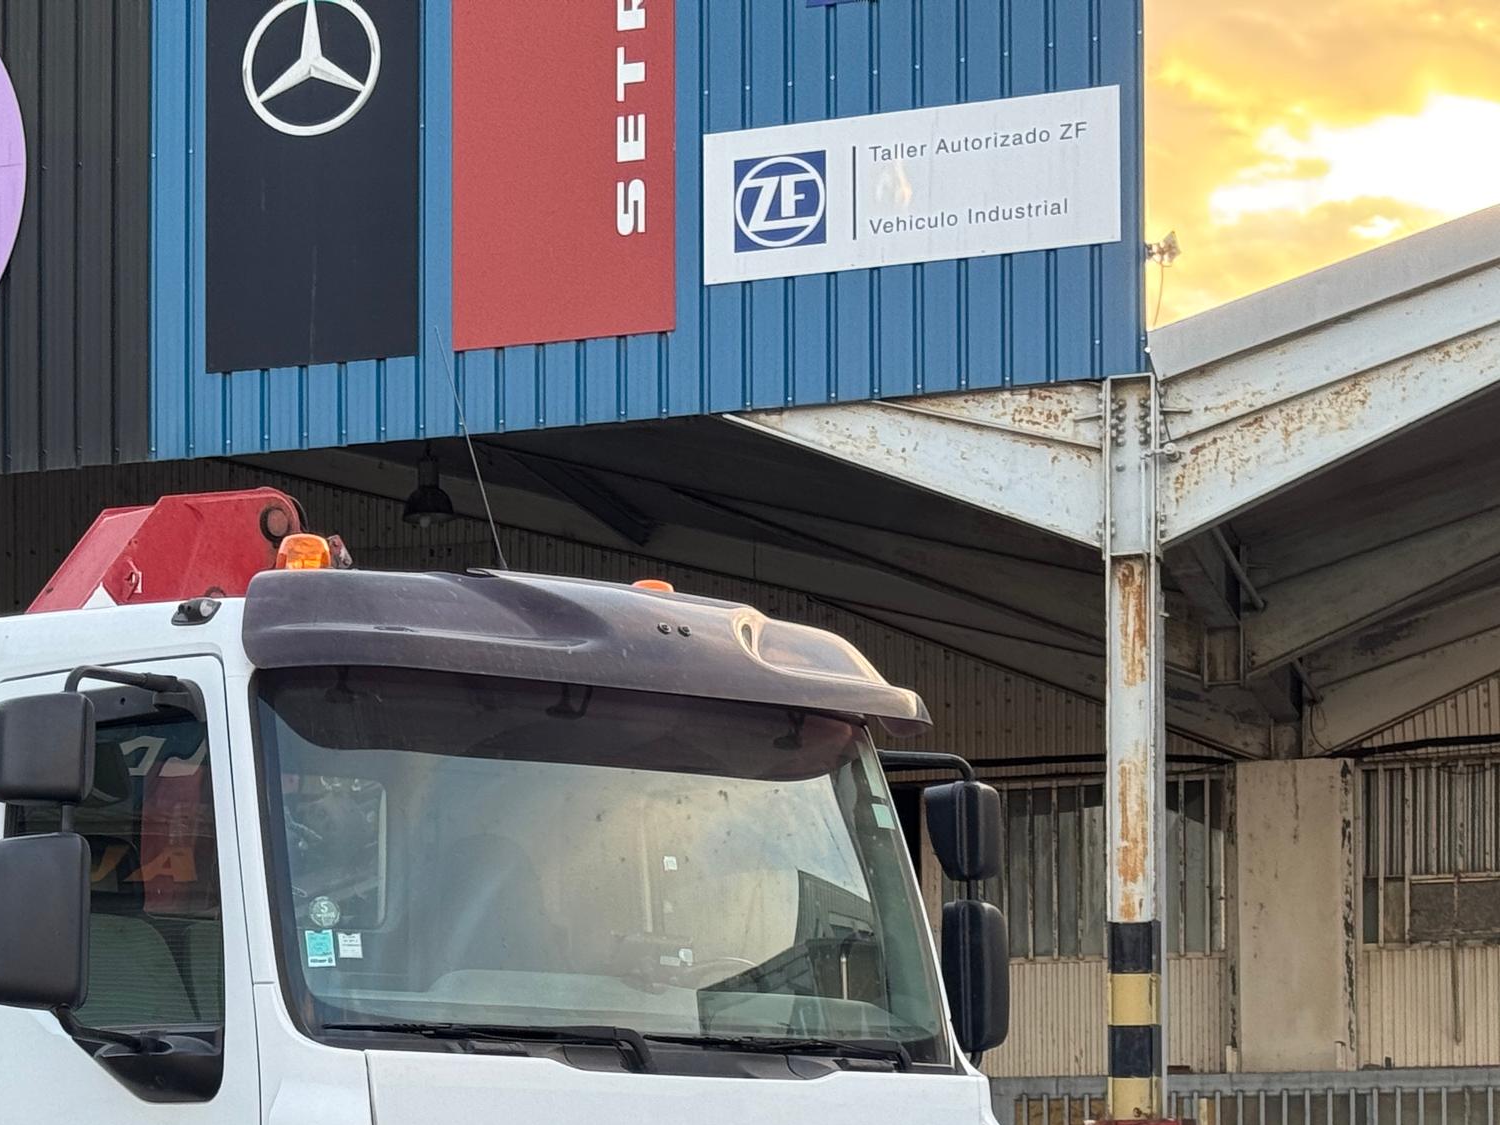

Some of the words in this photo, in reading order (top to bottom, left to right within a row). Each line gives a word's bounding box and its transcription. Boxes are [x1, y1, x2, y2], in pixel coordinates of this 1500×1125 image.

[869, 143, 927, 162] Taller
[936, 127, 1051, 155] Autorizado
[1060, 121, 1088, 141] ZF
[746, 173, 818, 232] ZF
[869, 212, 959, 235] Vehiculo
[967, 197, 1069, 225] Industrial
